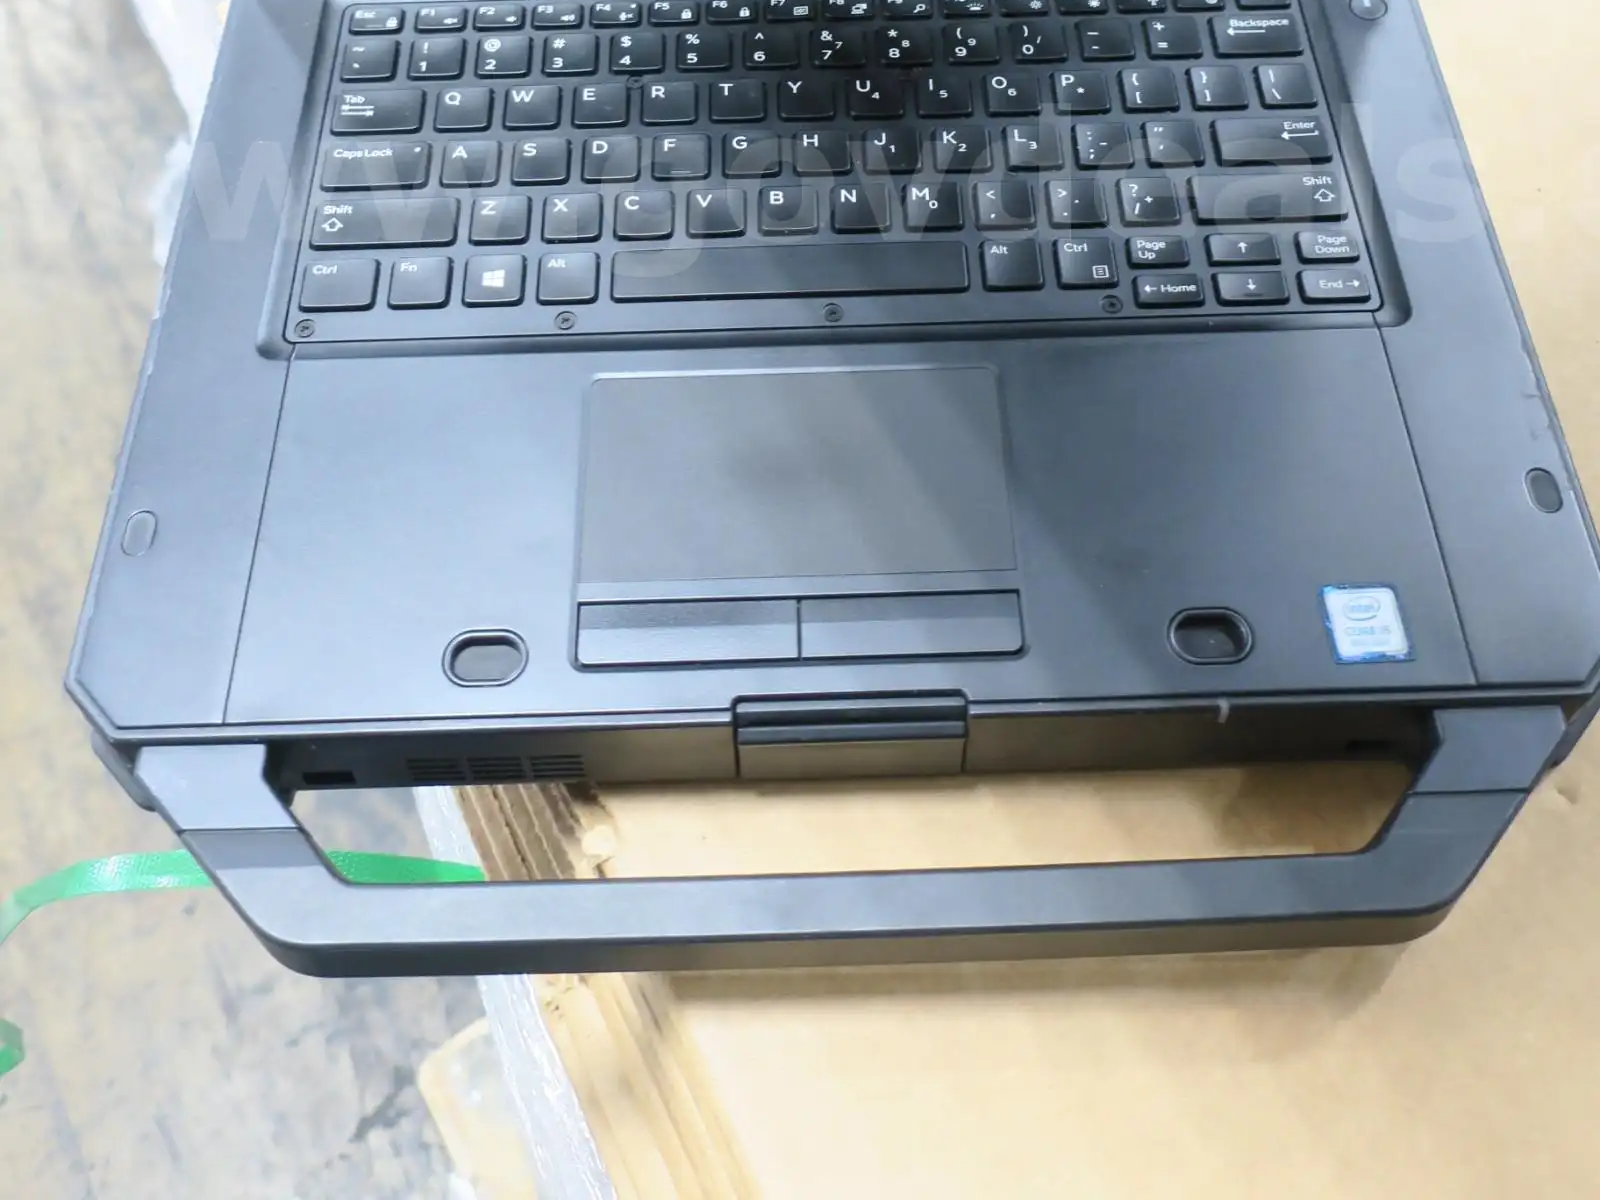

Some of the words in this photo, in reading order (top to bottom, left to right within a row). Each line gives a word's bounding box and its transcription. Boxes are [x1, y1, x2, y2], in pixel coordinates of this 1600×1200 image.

[480, 6, 495, 14] F2
[538, 5, 553, 13] F3
[655, 2, 670, 10] F5
[355, 10, 376, 18] Esc
[420, 8, 435, 17] F1
[1229, 19, 1289, 29] Backspace
[821, 31, 832, 40] &
[956, 27, 962, 39] (
[1022, 26, 1029, 37] )
[553, 38, 566, 48] #
[621, 36, 631, 47] $
[686, 34, 700, 44] %
[902, 39, 909, 48] 8
[422, 42, 428, 53] !
[484, 38, 501, 52] @
[1023, 45, 1033, 54] 0
[754, 51, 765, 61] 6
[822, 50, 832, 59] 7
[889, 48, 900, 57] 8
[955, 47, 966, 56] 9
[553, 58, 563, 67] 3
[620, 56, 631, 65] 4
[687, 53, 697, 63] 5
[419, 61, 426, 72] 1
[484, 59, 496, 71] 2
[1061, 75, 1074, 86] P
[1132, 72, 1139, 86] {
[1200, 71, 1208, 83] }
[788, 81, 801, 93] Y
[856, 80, 870, 92] U
[929, 79, 933, 91] I
[992, 76, 1007, 90] O
[583, 88, 595, 100] E
[652, 86, 664, 97] R
[719, 84, 733, 95] T
[344, 95, 365, 104] Tab
[445, 92, 461, 105] Q
[512, 90, 534, 102] W
[1136, 92, 1142, 103] [
[1204, 90, 1211, 101] ]
[1283, 121, 1316, 130] Enter
[803, 135, 818, 146] H
[874, 133, 886, 145] J
[943, 131, 956, 144] K
[1014, 129, 1026, 141] L
[593, 141, 608, 154] D
[664, 139, 676, 151] F
[732, 136, 747, 149] G
[956, 142, 966, 151] 2
[334, 149, 365, 159] Caps
[365, 148, 392, 157] Lock
[452, 146, 467, 158] A
[524, 143, 536, 156] S
[1303, 176, 1332, 185] Shift
[841, 189, 856, 202] N
[912, 188, 929, 200] M
[1058, 189, 1066, 197] >
[1129, 184, 1138, 196] ?
[625, 196, 639, 209] C
[696, 194, 712, 207] V
[770, 191, 783, 204] B
[324, 205, 352, 214] Shift
[481, 202, 496, 214] Z
[554, 199, 568, 211] X
[929, 200, 938, 209] 0
[1137, 240, 1166, 250] Page
[1317, 236, 1347, 245] Page
[990, 246, 1007, 254] Alt
[1064, 243, 1087, 252] Ctrl
[1315, 244, 1350, 254] Down
[1138, 249, 1156, 259] Up
[401, 262, 417, 271] Fn
[548, 259, 565, 267] Alt
[313, 265, 337, 274] Ctrl
[1161, 283, 1196, 292] Home
[1319, 280, 1343, 288] End
